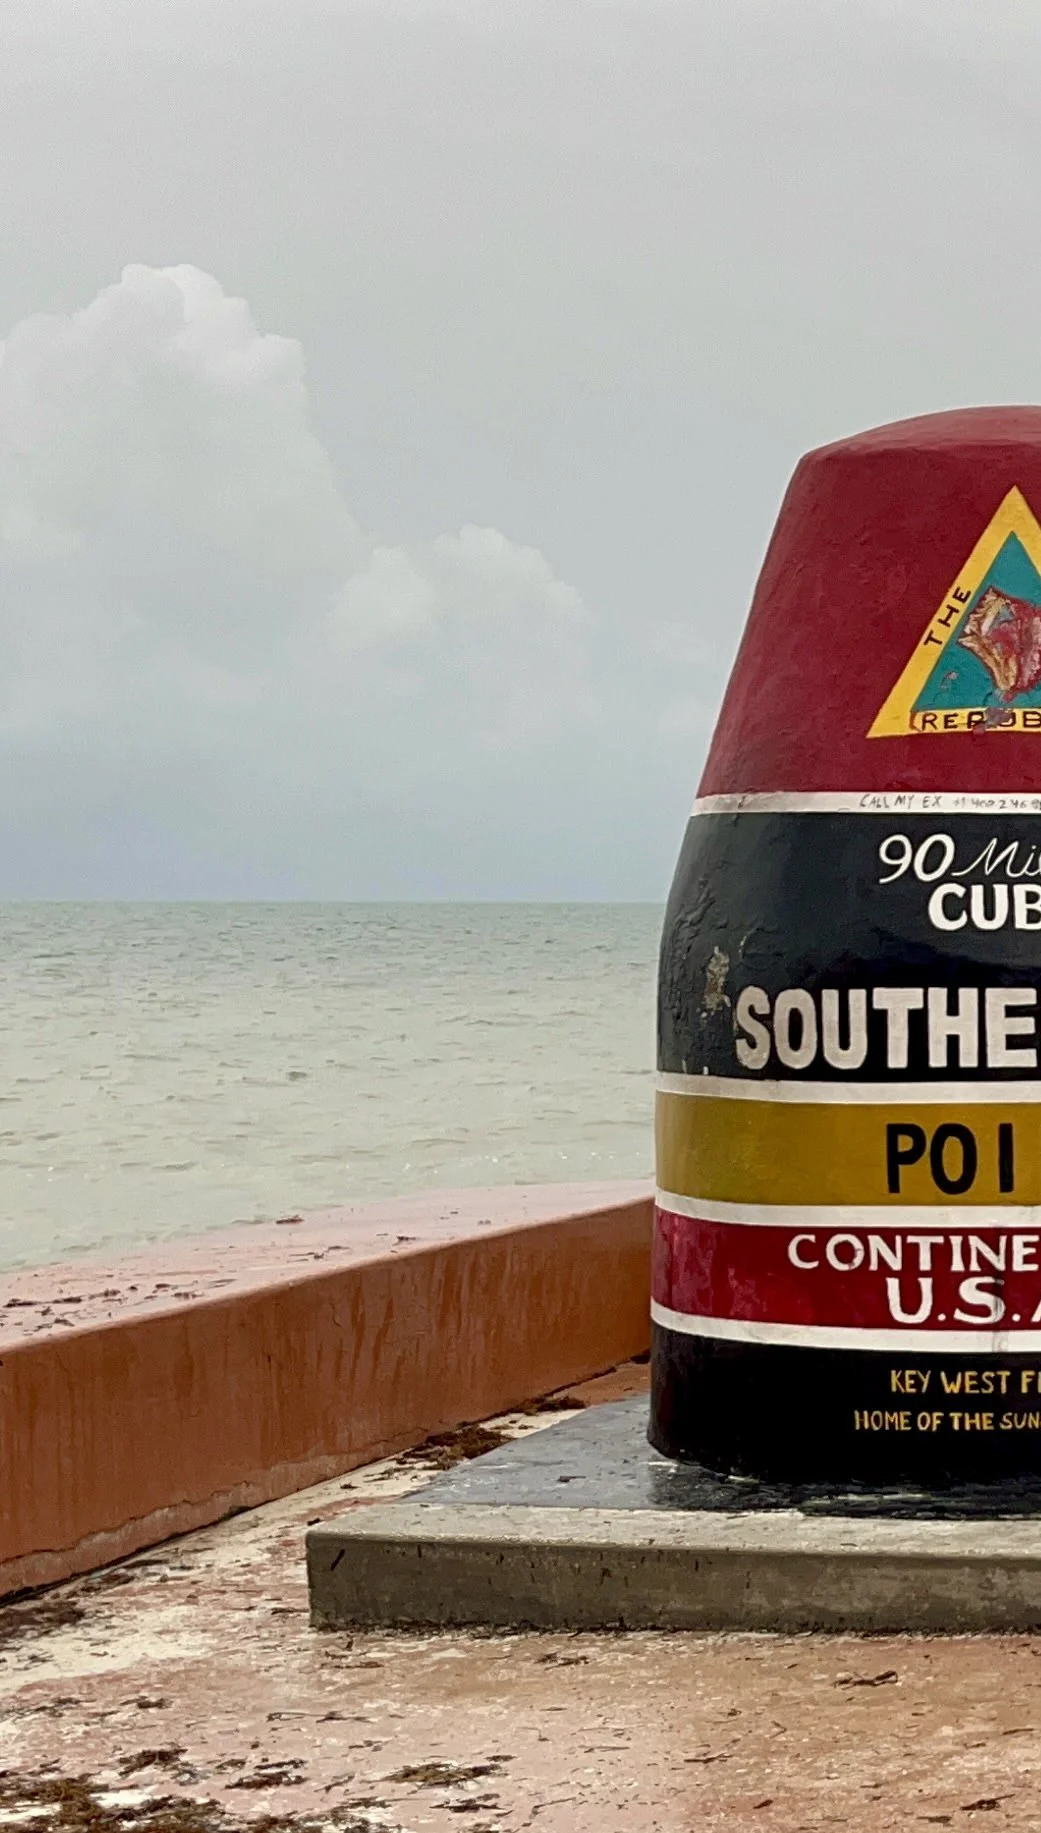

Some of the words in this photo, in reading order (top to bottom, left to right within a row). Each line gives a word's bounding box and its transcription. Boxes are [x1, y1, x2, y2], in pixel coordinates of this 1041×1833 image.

[923, 586, 972, 648] THE
[859, 793, 890, 809] CALL
[894, 794, 915, 810] MY
[922, 795, 943, 809] EX
[878, 833, 956, 884] 90
[890, 1370, 931, 1394] KEY
[940, 1370, 1011, 1395] WEST
[854, 1410, 912, 1431] HOME
[917, 1411, 944, 1431] OF
[949, 1412, 994, 1431] THE
